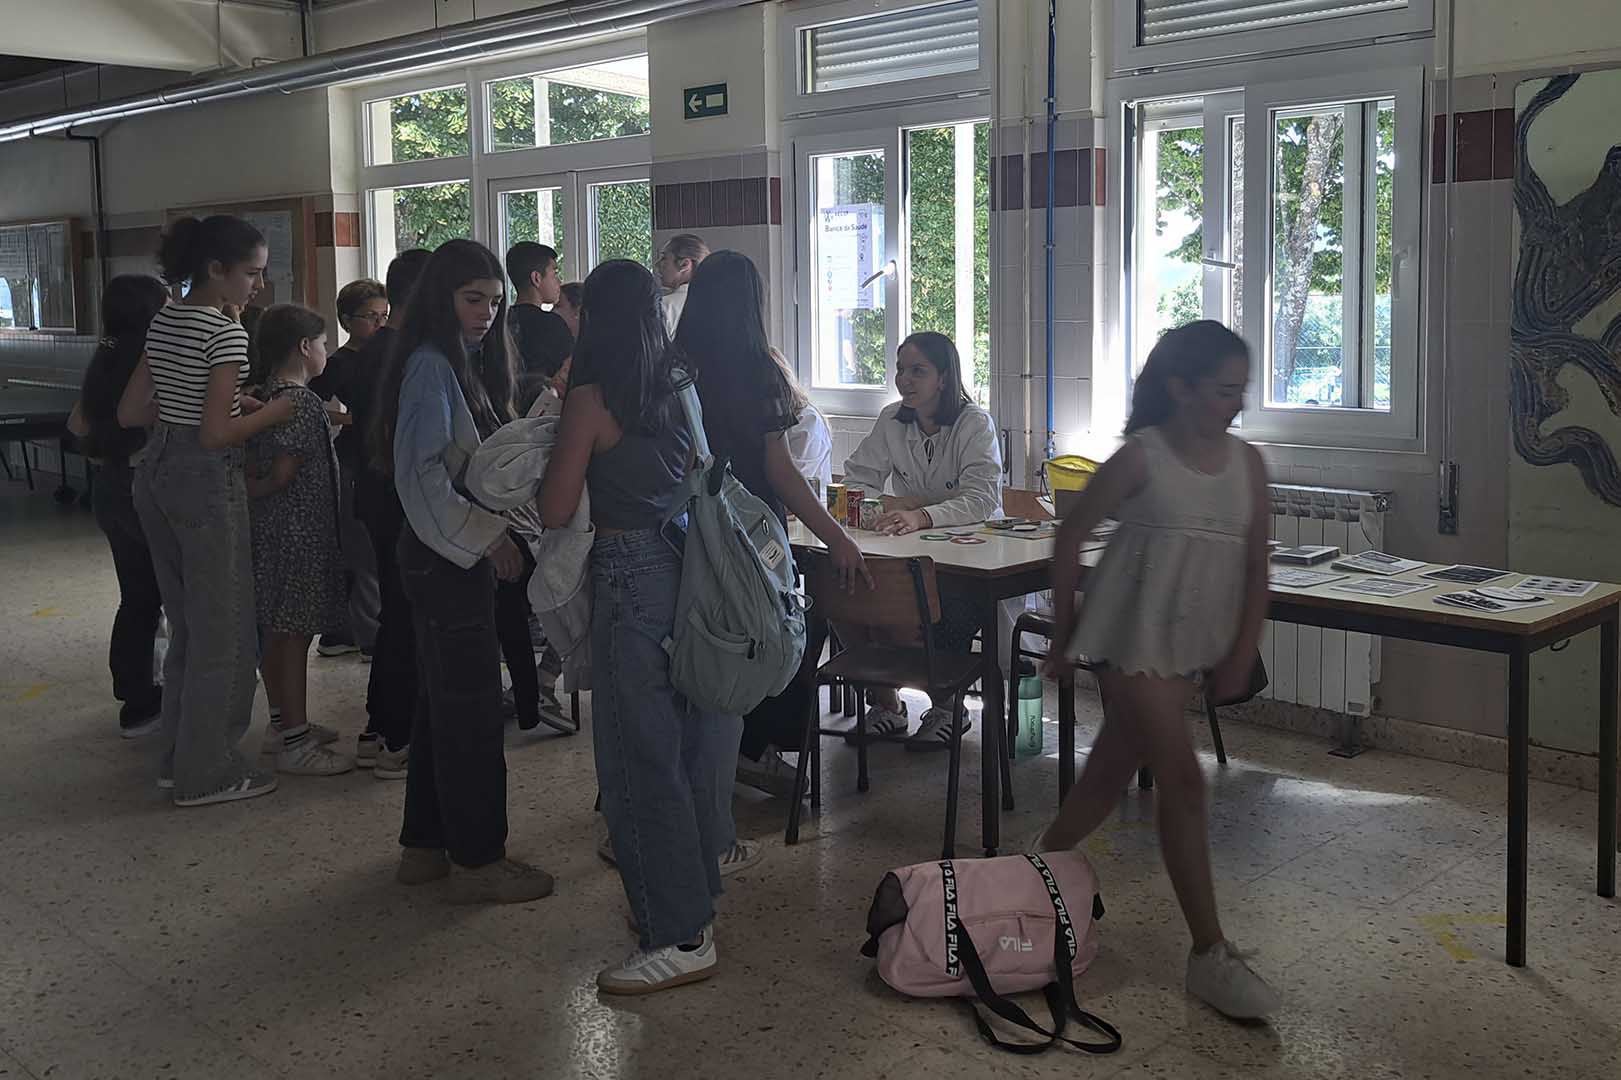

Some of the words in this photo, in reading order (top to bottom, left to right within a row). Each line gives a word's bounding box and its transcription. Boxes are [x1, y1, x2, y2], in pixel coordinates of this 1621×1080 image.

[945, 878, 955, 901] FILA
[1042, 868, 1059, 895] FILA
[946, 903, 957, 931] FILA
[1054, 896, 1070, 925] FILA
[947, 934, 958, 964] FILA
[998, 935, 1033, 953] FILA
